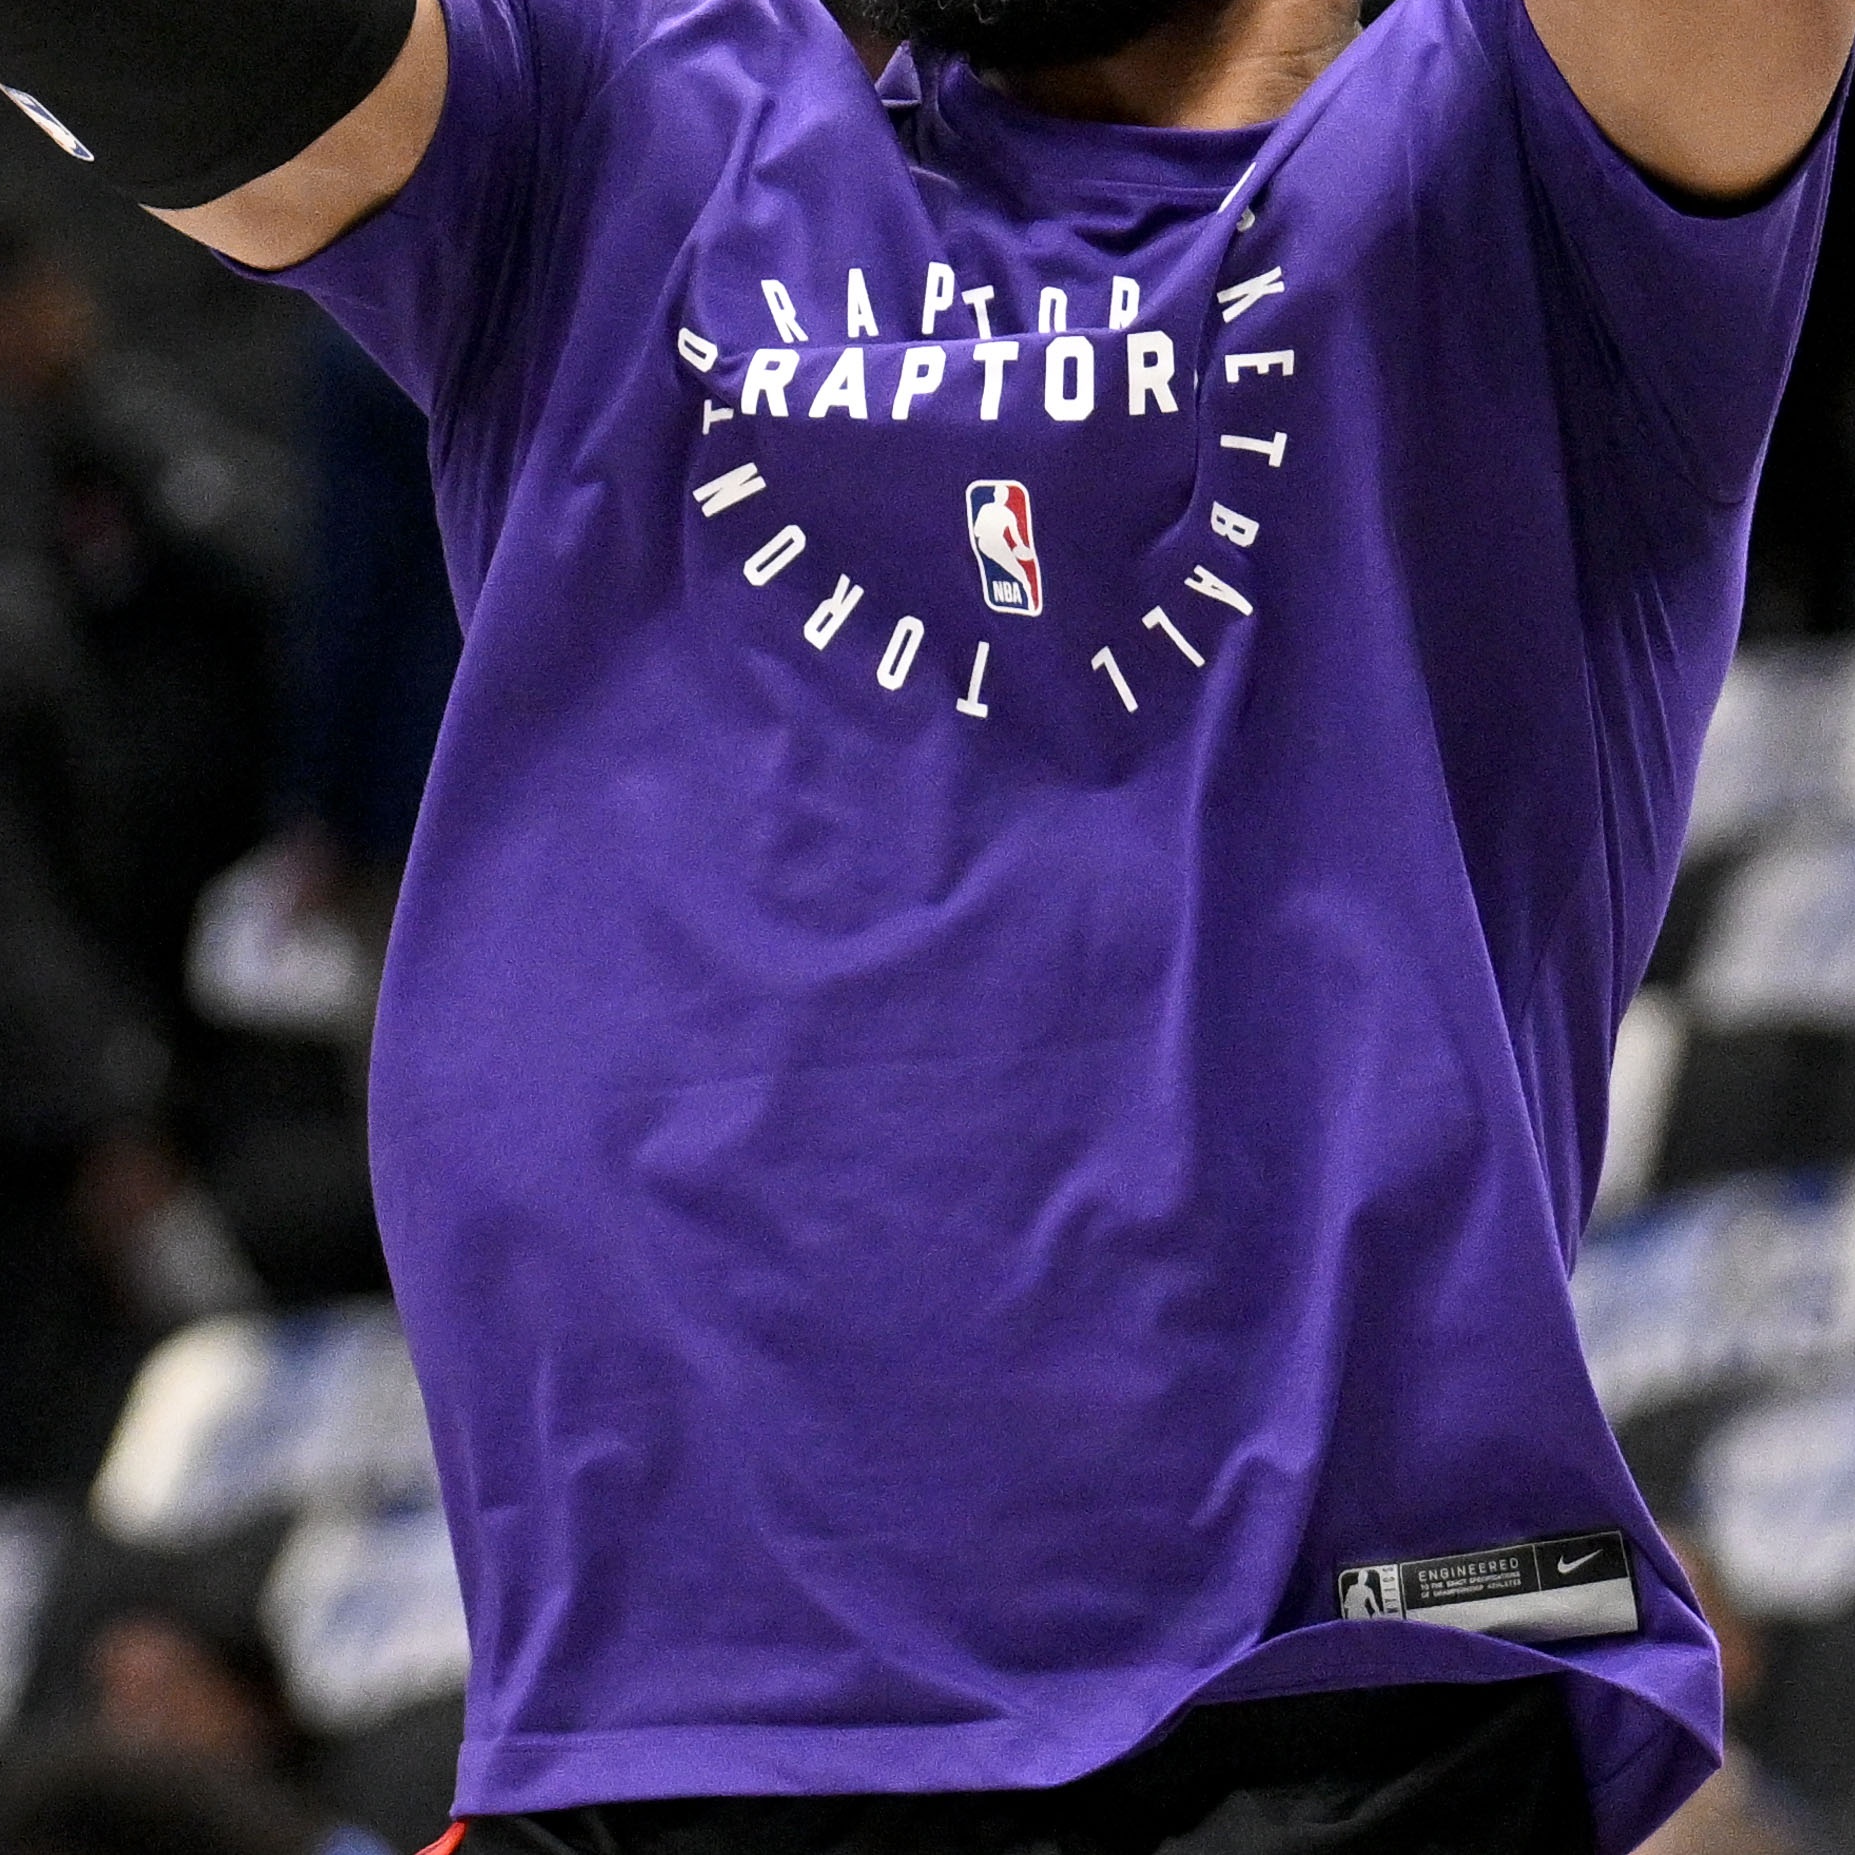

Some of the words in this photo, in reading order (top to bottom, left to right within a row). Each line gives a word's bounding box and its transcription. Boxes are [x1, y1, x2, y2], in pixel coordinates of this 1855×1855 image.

[740, 329, 1199, 421] RAPTOR
[760, 260, 1141, 343] RAPTOR
[1090, 206, 1295, 714] KETBALL
[992, 580, 1023, 605] NBA
[1417, 1556, 1520, 1583] ENGINEERED
